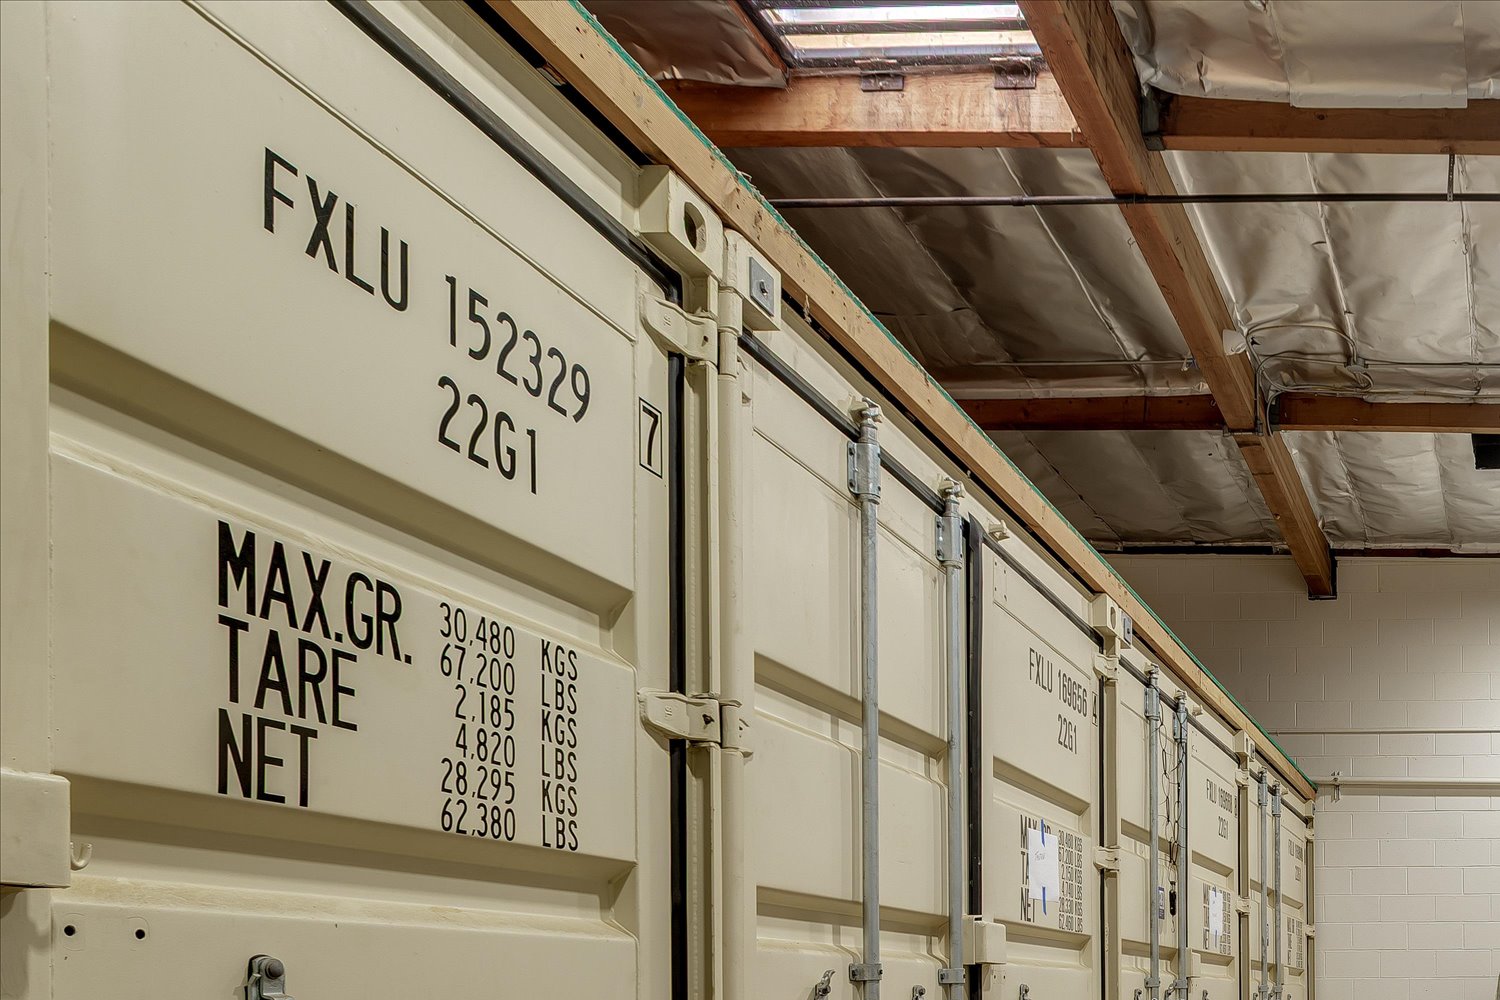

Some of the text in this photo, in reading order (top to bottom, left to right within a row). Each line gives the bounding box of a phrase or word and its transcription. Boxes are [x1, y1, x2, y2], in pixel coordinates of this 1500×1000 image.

[264, 147, 591, 424] FXLU 152329
[437, 376, 538, 495] 22G1
[641, 405, 660, 469] 7
[217, 520, 412, 665] MAX.GR.
[217, 613, 358, 732] TARE
[439, 602, 578, 682] 30,480 KGS
[1029, 647, 1053, 693] FXLU
[440, 642, 578, 715] 67,200 LBS
[455, 684, 578, 749] 2,185 KGS
[1057, 713, 1077, 755] 22G1
[217, 708, 319, 808] NET
[455, 723, 578, 783] 4,820 LBS
[440, 758, 578, 818] 28,295 KGS
[440, 797, 579, 852] 62,380 LBS
